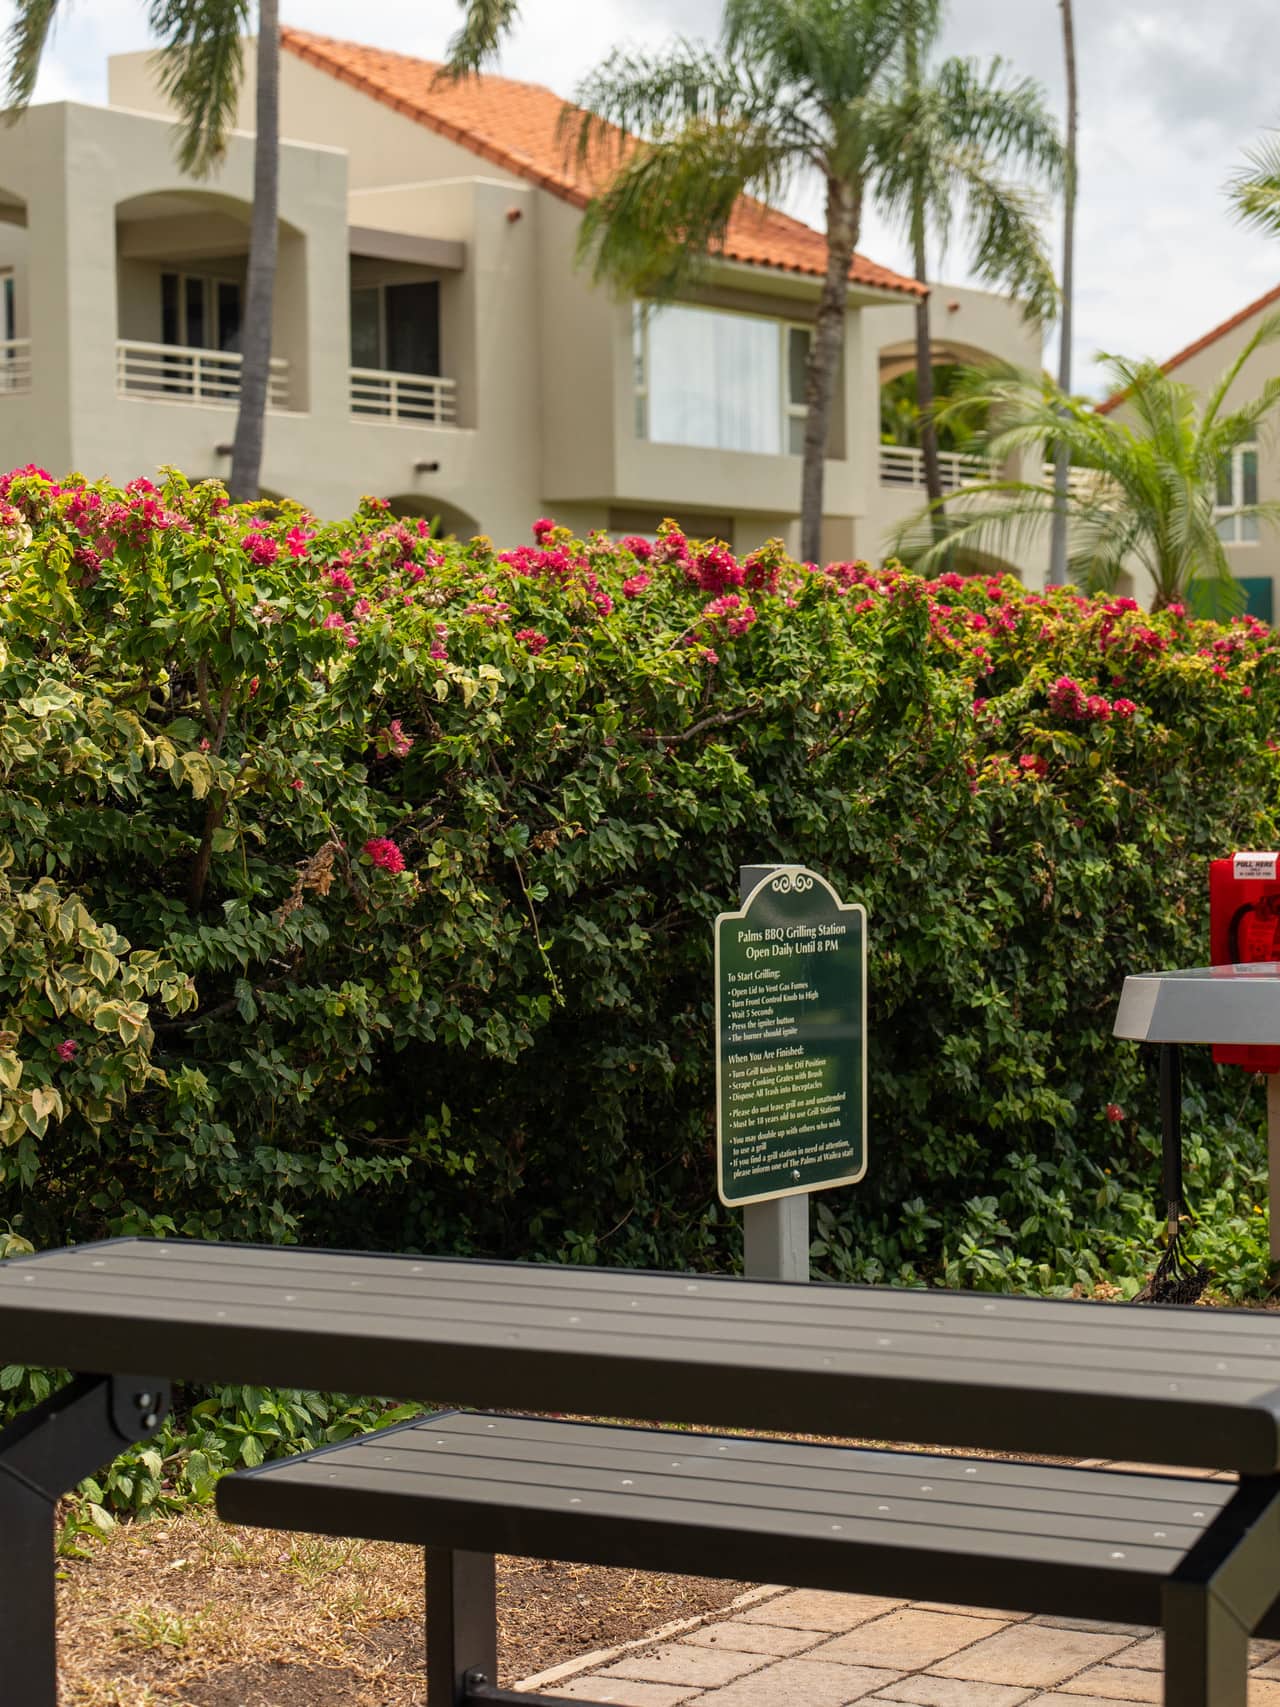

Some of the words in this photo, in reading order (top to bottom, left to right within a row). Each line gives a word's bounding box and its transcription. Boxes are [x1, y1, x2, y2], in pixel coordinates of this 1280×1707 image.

[738, 930, 762, 943] Palms
[765, 928, 784, 941] BBQ
[787, 925, 816, 939] Grilling
[819, 923, 846, 936] Station
[746, 946, 769, 960] Open
[772, 943, 794, 957] Daily
[796, 941, 815, 953] Until
[817, 941, 823, 951] 8
[825, 940, 838, 951] PM
[728, 973, 736, 982] To
[738, 972, 753, 981] Start
[732, 988, 747, 997] Open
[749, 986, 758, 994] Lid
[779, 983, 790, 991] Gas
[791, 982, 808, 990] Fumes
[732, 1000, 745, 1008] Turn
[746, 998, 760, 1006] Front
[761, 994, 782, 1004] Control
[783, 993, 798, 1001] Knob
[806, 991, 819, 1000] High
[731, 1011, 745, 1019] Wait
[751, 1007, 774, 1016] Seconds
[747, 1020, 757, 1028] the
[732, 1034, 742, 1042] The
[744, 1032, 762, 1040] burner
[763, 1027, 781, 1038] should
[728, 1054, 748, 1064] When
[749, 1053, 762, 1061] You
[763, 1050, 775, 1059] Are
[776, 1045, 805, 1058] Finished:
[746, 1067, 759, 1075] Grill
[760, 1065, 777, 1074] Knobs
[785, 1062, 794, 1070] the
[795, 1060, 805, 1068] Off
[805, 1058, 826, 1067] Position
[732, 1081, 751, 1090] Scrape
[752, 1077, 775, 1086] Cooking
[776, 1075, 794, 1083] Grates
[808, 1070, 823, 1078] Brush
[733, 1093, 755, 1102] Dispose
[756, 1089, 764, 1097] All
[765, 1087, 779, 1096] Trash
[780, 1085, 791, 1093] into
[792, 1081, 823, 1091] Receptacles
[733, 1108, 750, 1117] Please
[751, 1106, 759, 1114] do
[786, 1099, 796, 1110] grill
[806, 1096, 816, 1105] and
[817, 1092, 846, 1104] unattended
[748, 1118, 755, 1126] be
[757, 1117, 763, 1125] 18
[765, 1115, 779, 1125] years
[780, 1112, 789, 1121] old
[807, 1107, 819, 1116] Grill
[820, 1106, 840, 1114] Stations
[733, 1136, 744, 1145] You
[745, 1135, 757, 1144] may
[758, 1131, 777, 1140] double
[778, 1130, 785, 1138] up
[786, 1126, 798, 1135] with
[799, 1124, 815, 1133] others
[829, 1118, 840, 1127] wish
[733, 1159, 739, 1167] If
[739, 1158, 750, 1167] you
[751, 1155, 762, 1164] find
[767, 1151, 778, 1162] grill
[779, 1147, 797, 1158] station
[798, 1147, 804, 1155] in
[805, 1144, 818, 1154] need
[819, 1142, 825, 1151] of
[825, 1140, 850, 1149] attention,
[756, 1142, 767, 1153] grill
[733, 1169, 751, 1180] please
[752, 1164, 771, 1174] inform
[782, 1160, 789, 1168] of
[790, 1158, 800, 1167] The
[801, 1156, 817, 1164] Palms
[842, 1147, 854, 1157] staff
